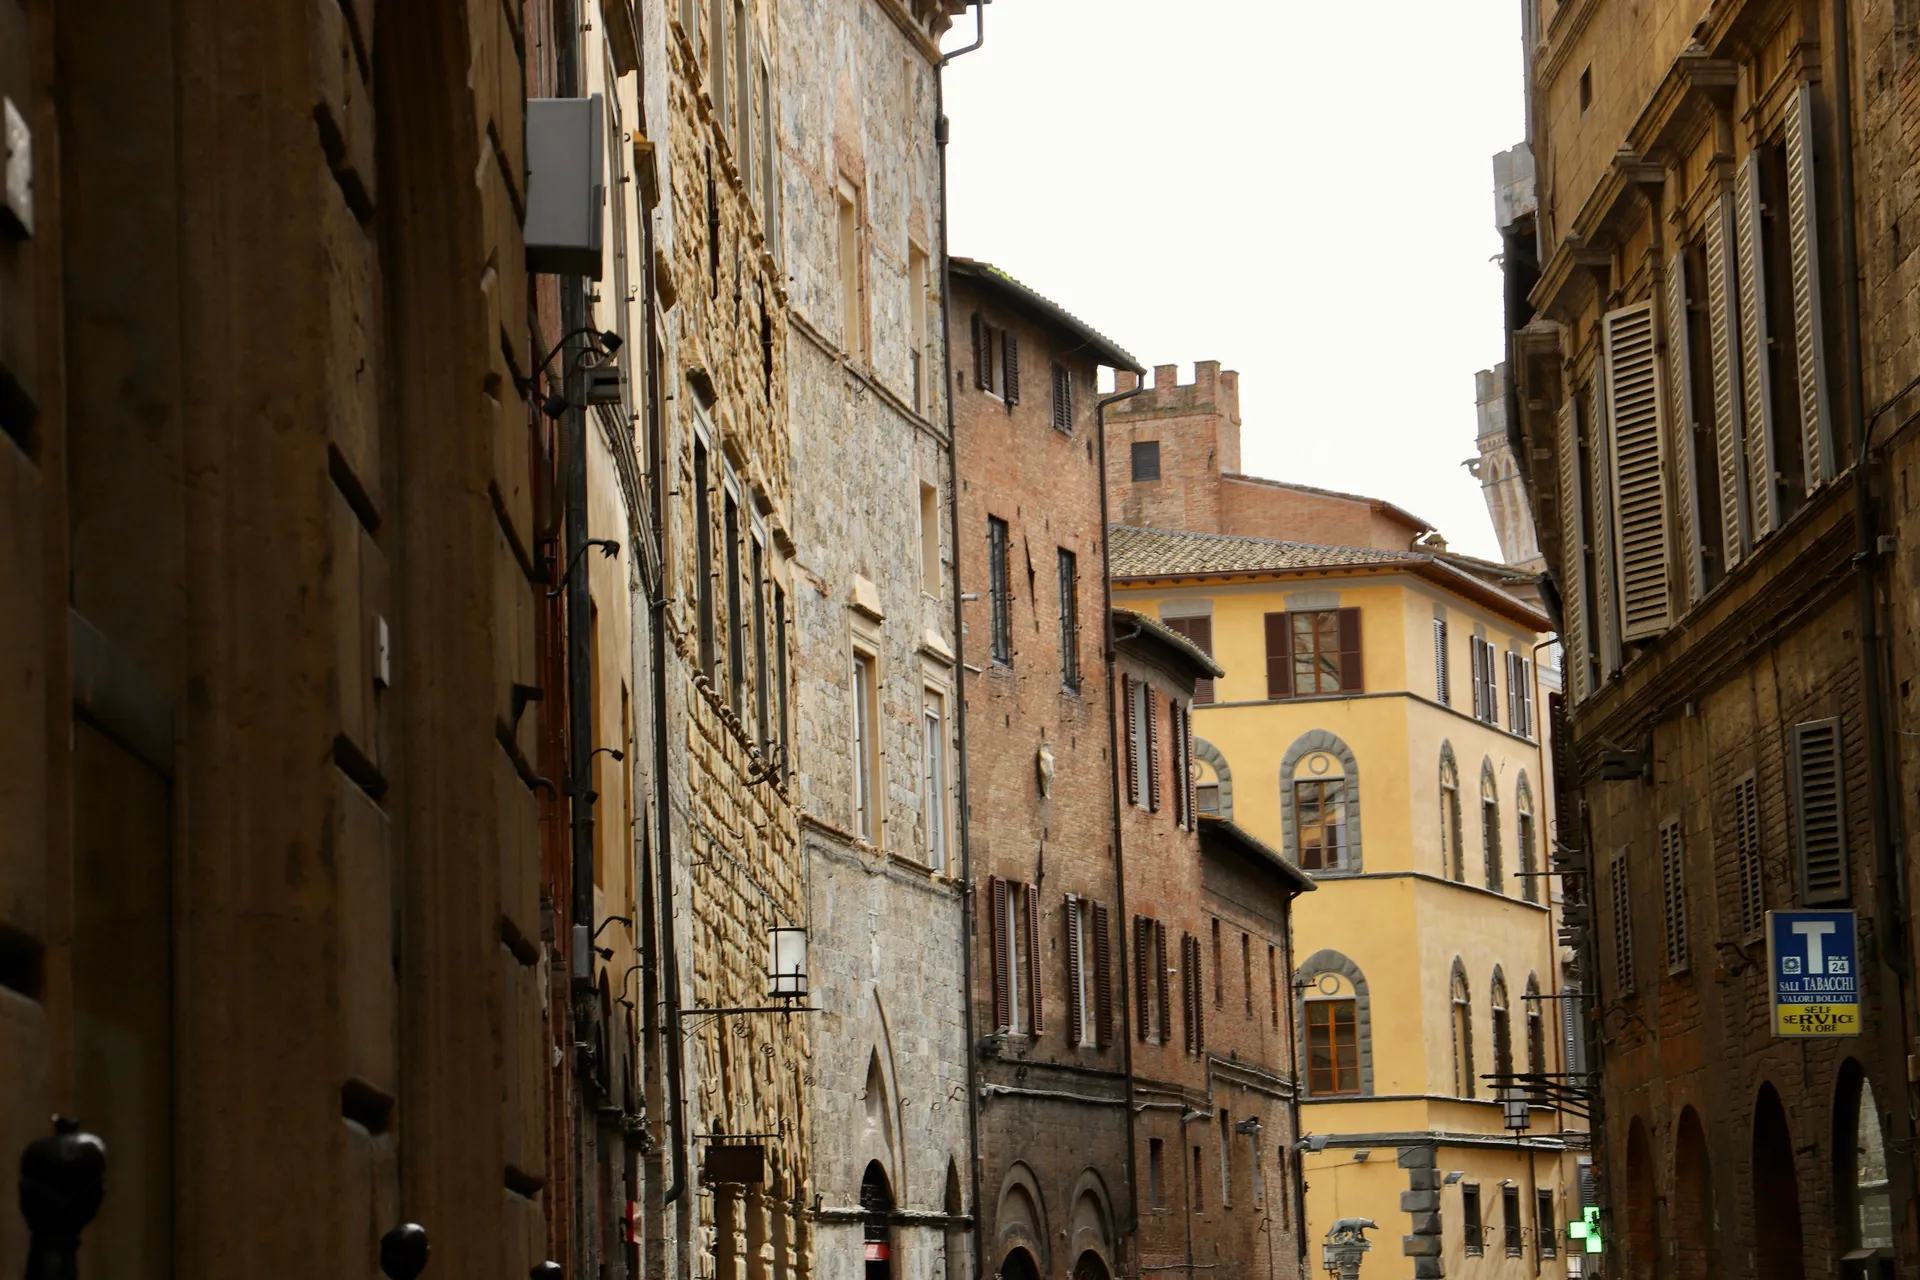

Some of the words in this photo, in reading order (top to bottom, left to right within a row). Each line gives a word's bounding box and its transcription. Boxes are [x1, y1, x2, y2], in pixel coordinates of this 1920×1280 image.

[1792, 921, 1836, 974] T
[1832, 962, 1846, 972] 24
[1779, 982, 1799, 991] SALI
[1803, 977, 1854, 991] TABACCHI
[1782, 995, 1814, 1003] VALORI
[1816, 995, 1853, 1003] BOLLATI
[1804, 1006, 1831, 1014] SELF
[1783, 1014, 1854, 1024] SERVICE
[1815, 1024, 1837, 1033] ORE
